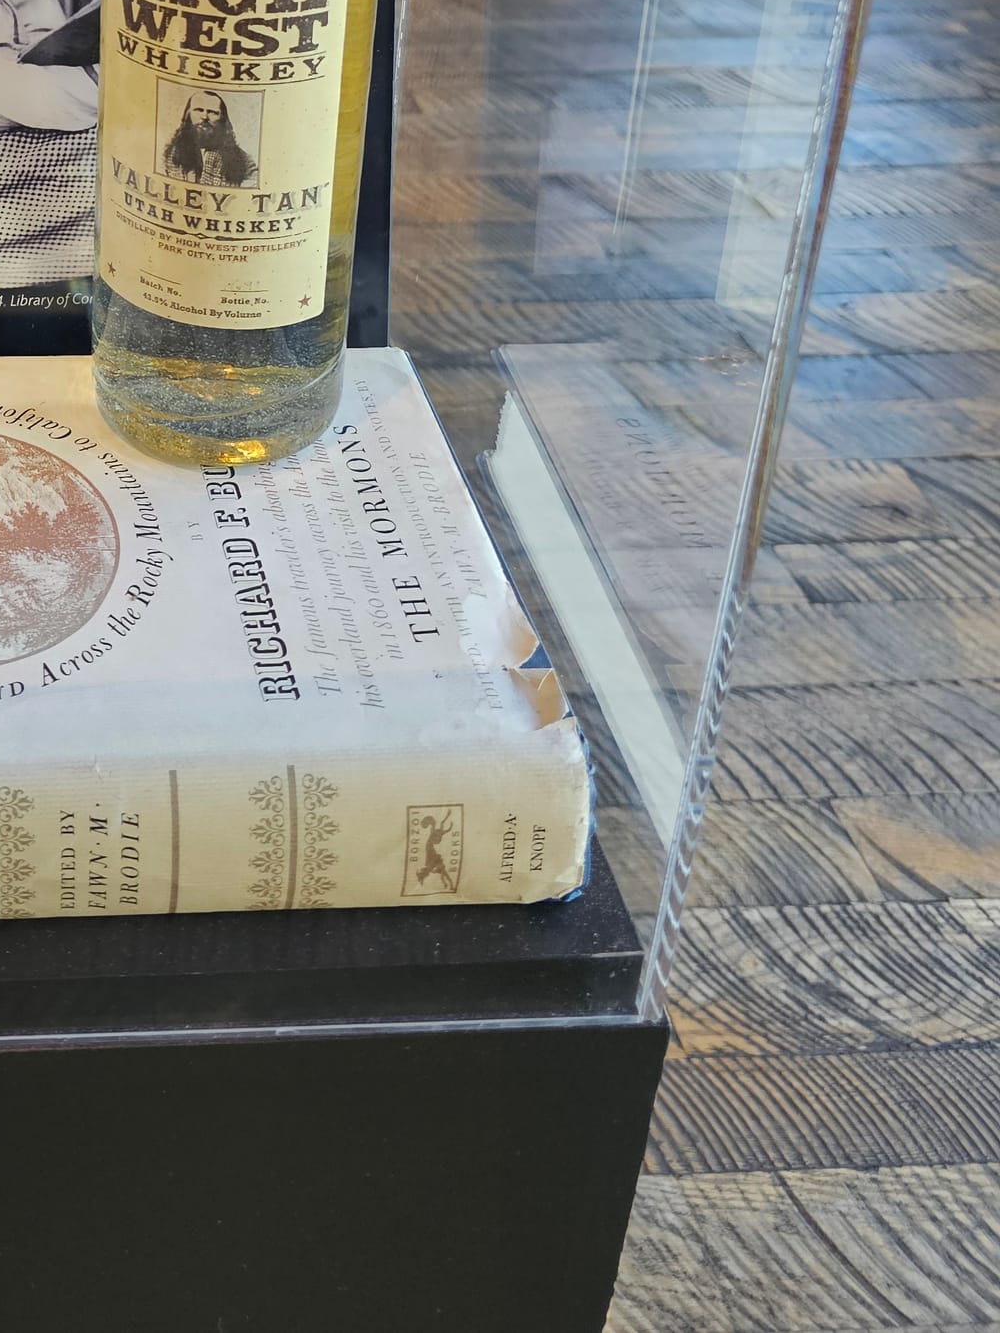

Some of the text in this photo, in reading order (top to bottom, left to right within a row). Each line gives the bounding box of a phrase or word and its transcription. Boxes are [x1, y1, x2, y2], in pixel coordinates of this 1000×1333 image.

[115, 29, 326, 82] WHISKEY
[111, 155, 320, 214] VALLEY TAN
[123, 192, 174, 224] UTAH
[116, 211, 157, 237] DISTILLED
[158, 232, 172, 242] BY
[175, 237, 202, 250] HIGH
[205, 241, 238, 252] WEST
[157, 241, 248, 263] PARK CITY, UTAH
[10, 293, 55, 310] Library
[56, 292, 72, 309] of
[139, 275, 183, 298] Batch No.
[220, 296, 252, 306] Bottle
[169, 301, 208, 317] Alcohol
[209, 309, 224, 319] By
[224, 309, 262, 319] Volume
[353, 377, 371, 392] BY
[72, 433, 94, 458] to
[377, 435, 400, 462] AND
[97, 448, 165, 543] Mountains
[290, 478, 314, 500] the
[314, 467, 340, 489] the
[213, 503, 252, 530] F.
[322, 491, 346, 504] to
[186, 520, 204, 542] BY
[304, 502, 330, 543] across
[328, 507, 361, 537] visit
[332, 423, 440, 643] THE MORMONS
[389, 464, 444, 572] INTRODUCTION
[273, 524, 313, 592] traveler's
[339, 538, 369, 562] his
[128, 547, 175, 610] Rocky
[312, 545, 357, 603] journey
[347, 563, 379, 596] and
[436, 571, 456, 591] AN
[105, 604, 142, 639] the
[221, 535, 301, 703] RICHARD
[297, 595, 340, 662] famous
[365, 597, 397, 640] 1860
[445, 595, 475, 637] WITH
[330, 606, 375, 678] overland
[40, 635, 115, 688] Across
[312, 663, 344, 698] The
[358, 681, 386, 710] his
[410, 809, 421, 865] BORZOI
[449, 829, 461, 874] BOOKS
[530, 823, 548, 872] KNOPF
[60, 808, 76, 910] EDITED BY
[119, 810, 142, 907] BRODIE
